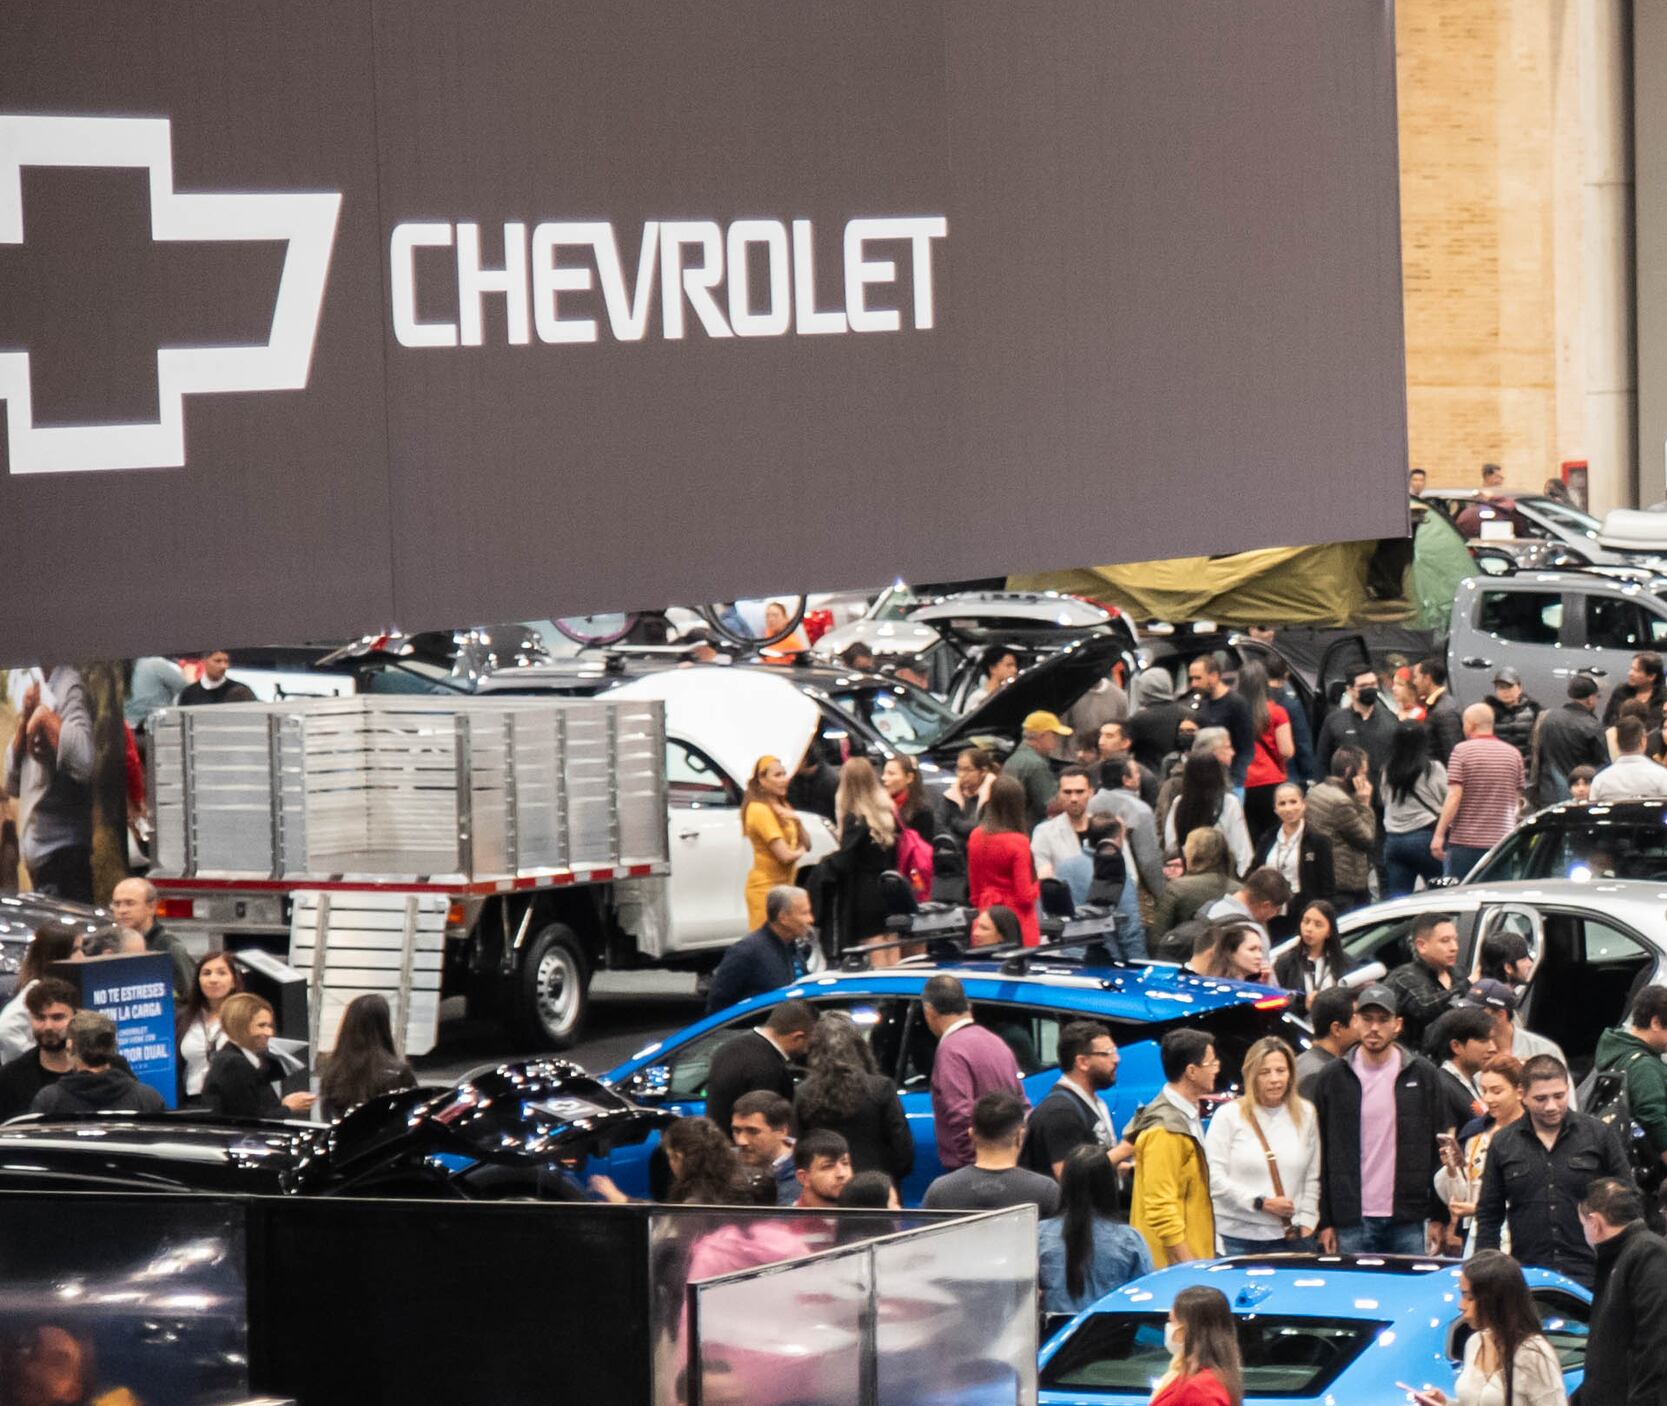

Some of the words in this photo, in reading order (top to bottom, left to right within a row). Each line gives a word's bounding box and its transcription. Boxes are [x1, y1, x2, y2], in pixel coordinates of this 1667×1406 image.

[390, 216, 948, 348] CHEVROLET
[94, 990, 108, 1006] NO
[108, 988, 120, 1004] TE
[121, 982, 166, 1003] ESTRESES
[118, 1005, 131, 1021] LA
[131, 1002, 162, 1019] CARGA
[143, 1043, 169, 1061] DUAL
